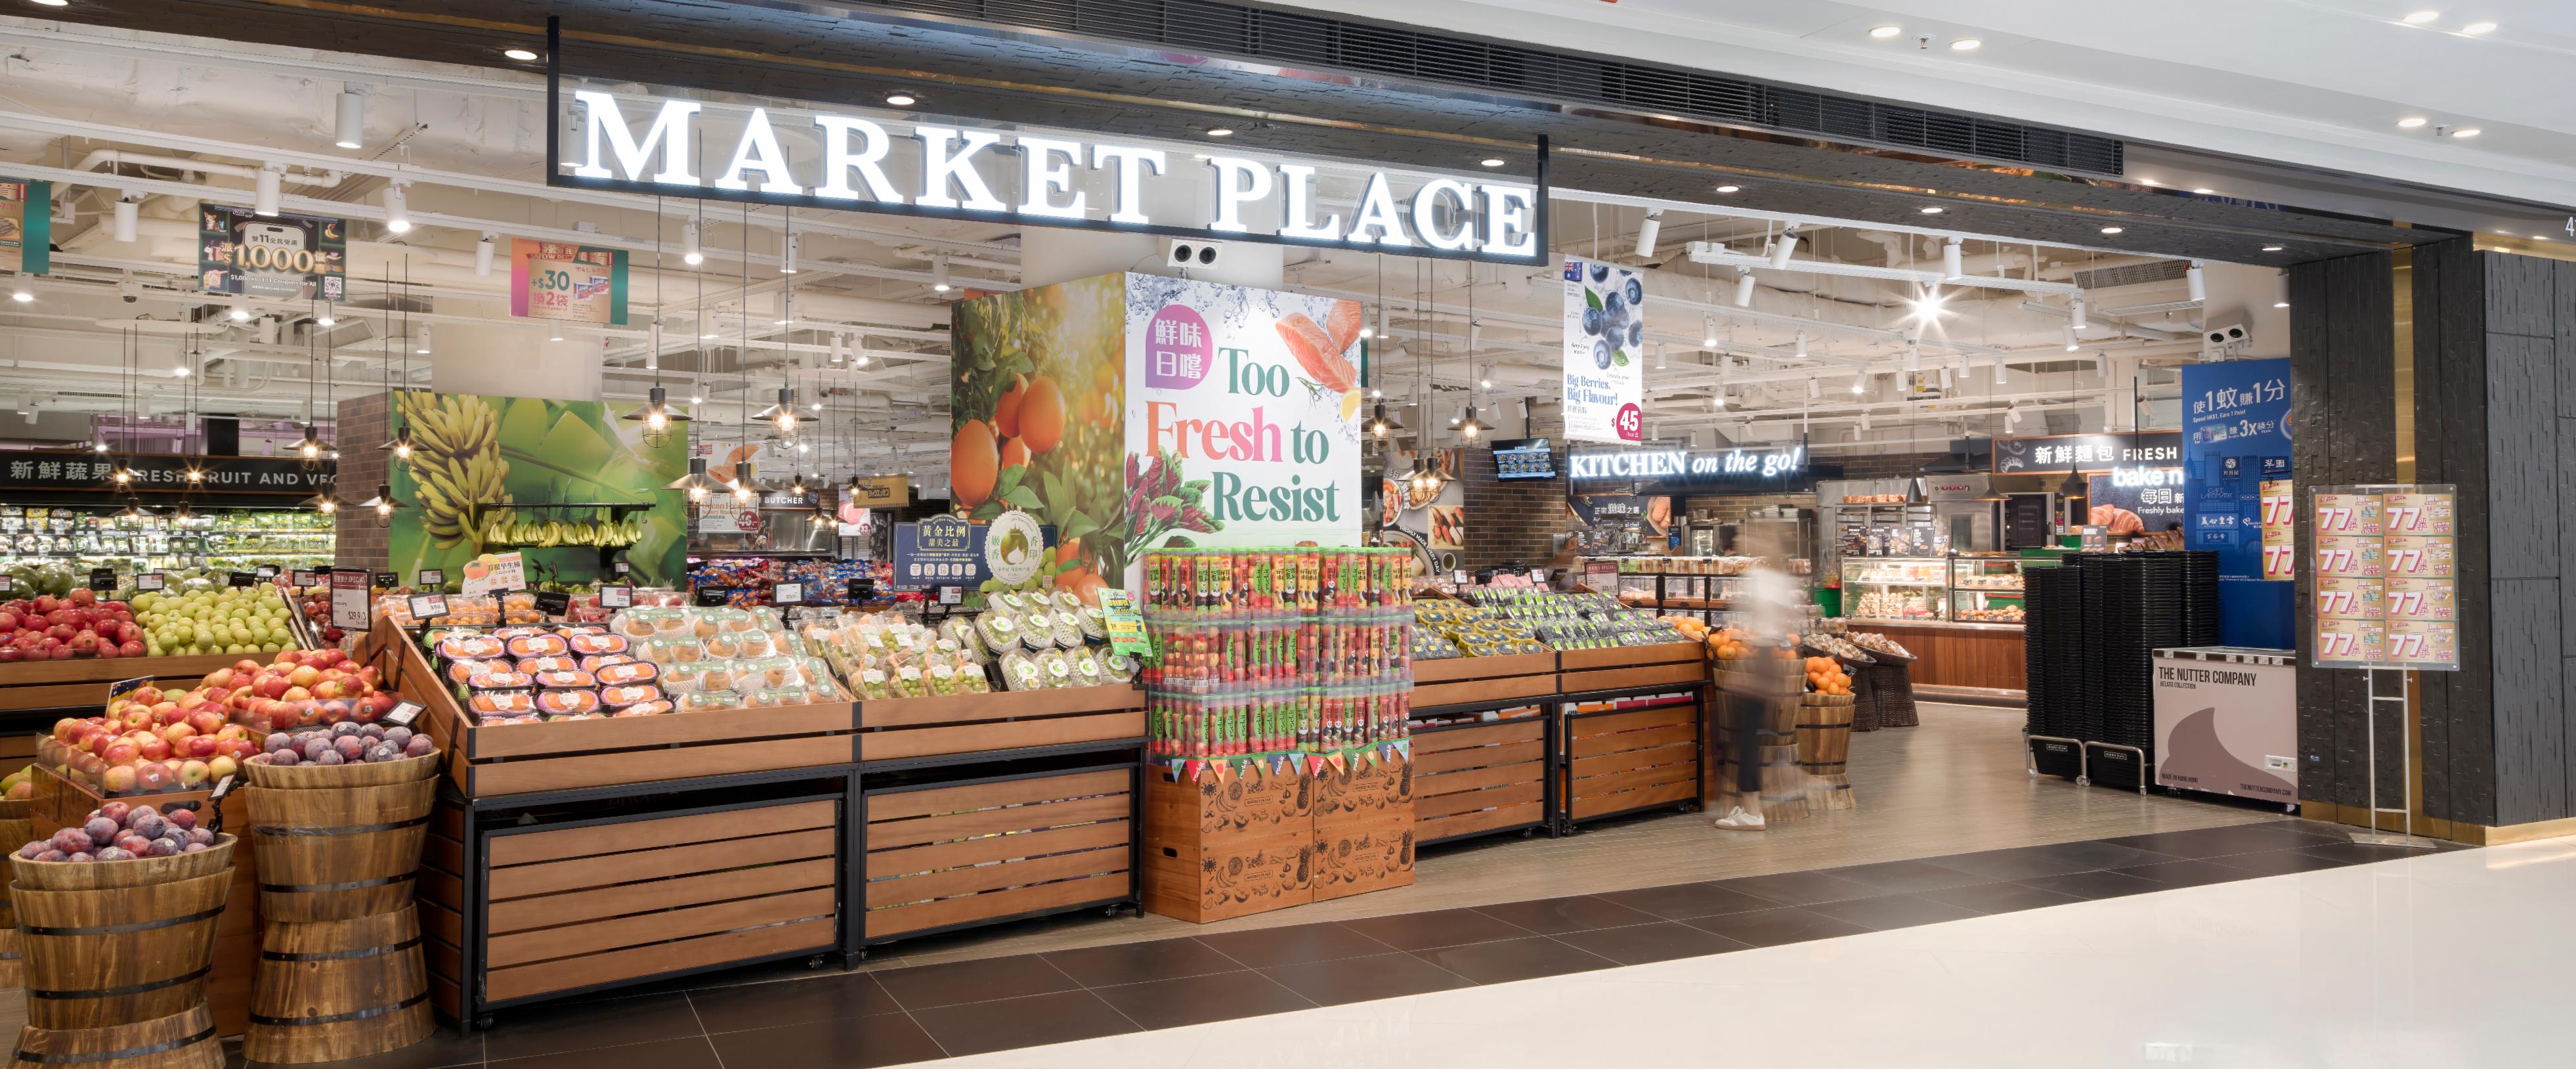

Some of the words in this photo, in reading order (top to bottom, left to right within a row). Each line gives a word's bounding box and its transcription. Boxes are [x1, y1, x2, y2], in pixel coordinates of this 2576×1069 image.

[574, 89, 1166, 225] MARKET
[1207, 156, 1537, 257] PLACE
[273, 278, 298, 287] Coupons
[532, 270, 570, 291] +$30
[1155, 318, 1202, 348] 鮮味
[1218, 347, 1290, 397] Too
[1567, 374, 1579, 389] Big
[1581, 375, 1610, 389] Berries.
[1567, 387, 1581, 404] Big
[1583, 389, 1618, 406] Flavour!
[2193, 378, 2285, 414] 使1蚊賺1分
[1145, 401, 1283, 462] Fresh
[1291, 420, 1329, 464] to
[2193, 432, 2201, 441] 用
[1570, 451, 1687, 477] KITCHEN
[1692, 456, 1718, 473] on
[1725, 449, 1757, 472] the
[1762, 447, 1801, 477] go!
[2034, 445, 2114, 464] 新鮮麵包
[2122, 447, 2178, 461] FRESH
[10, 460, 112, 481] 新鮮蔬果
[259, 473, 299, 485] AND
[2112, 466, 2165, 487] bake
[1212, 471, 1341, 523] Resist
[2137, 506, 2165, 516] Freshly
[2319, 508, 2353, 531] 77
[2386, 508, 2422, 531] 77
[922, 525, 966, 537] 黃金比例
[928, 538, 959, 547] 甜美之最
[1400, 525, 1417, 538] FRESHLY
[1415, 533, 1428, 548] MADE
[1425, 544, 1438, 561] EVERY
[2319, 549, 2353, 573] 77
[2387, 550, 2422, 573] 77
[2320, 591, 2355, 614] 77
[2388, 592, 2424, 615] 77
[2321, 632, 2355, 656] 77
[2389, 634, 2424, 657] 77
[2158, 666, 2174, 680] THE
[2177, 668, 2210, 683] NUTTER
[2212, 670, 2257, 686] COMPANY
[1193, 761, 1206, 782] rockit
[1239, 759, 1248, 780] rockit
[1276, 756, 1285, 775] rockit
[1314, 758, 1325, 777] rockit
[2240, 783, 2292, 796] THENUTTERCOMPANY.COM
